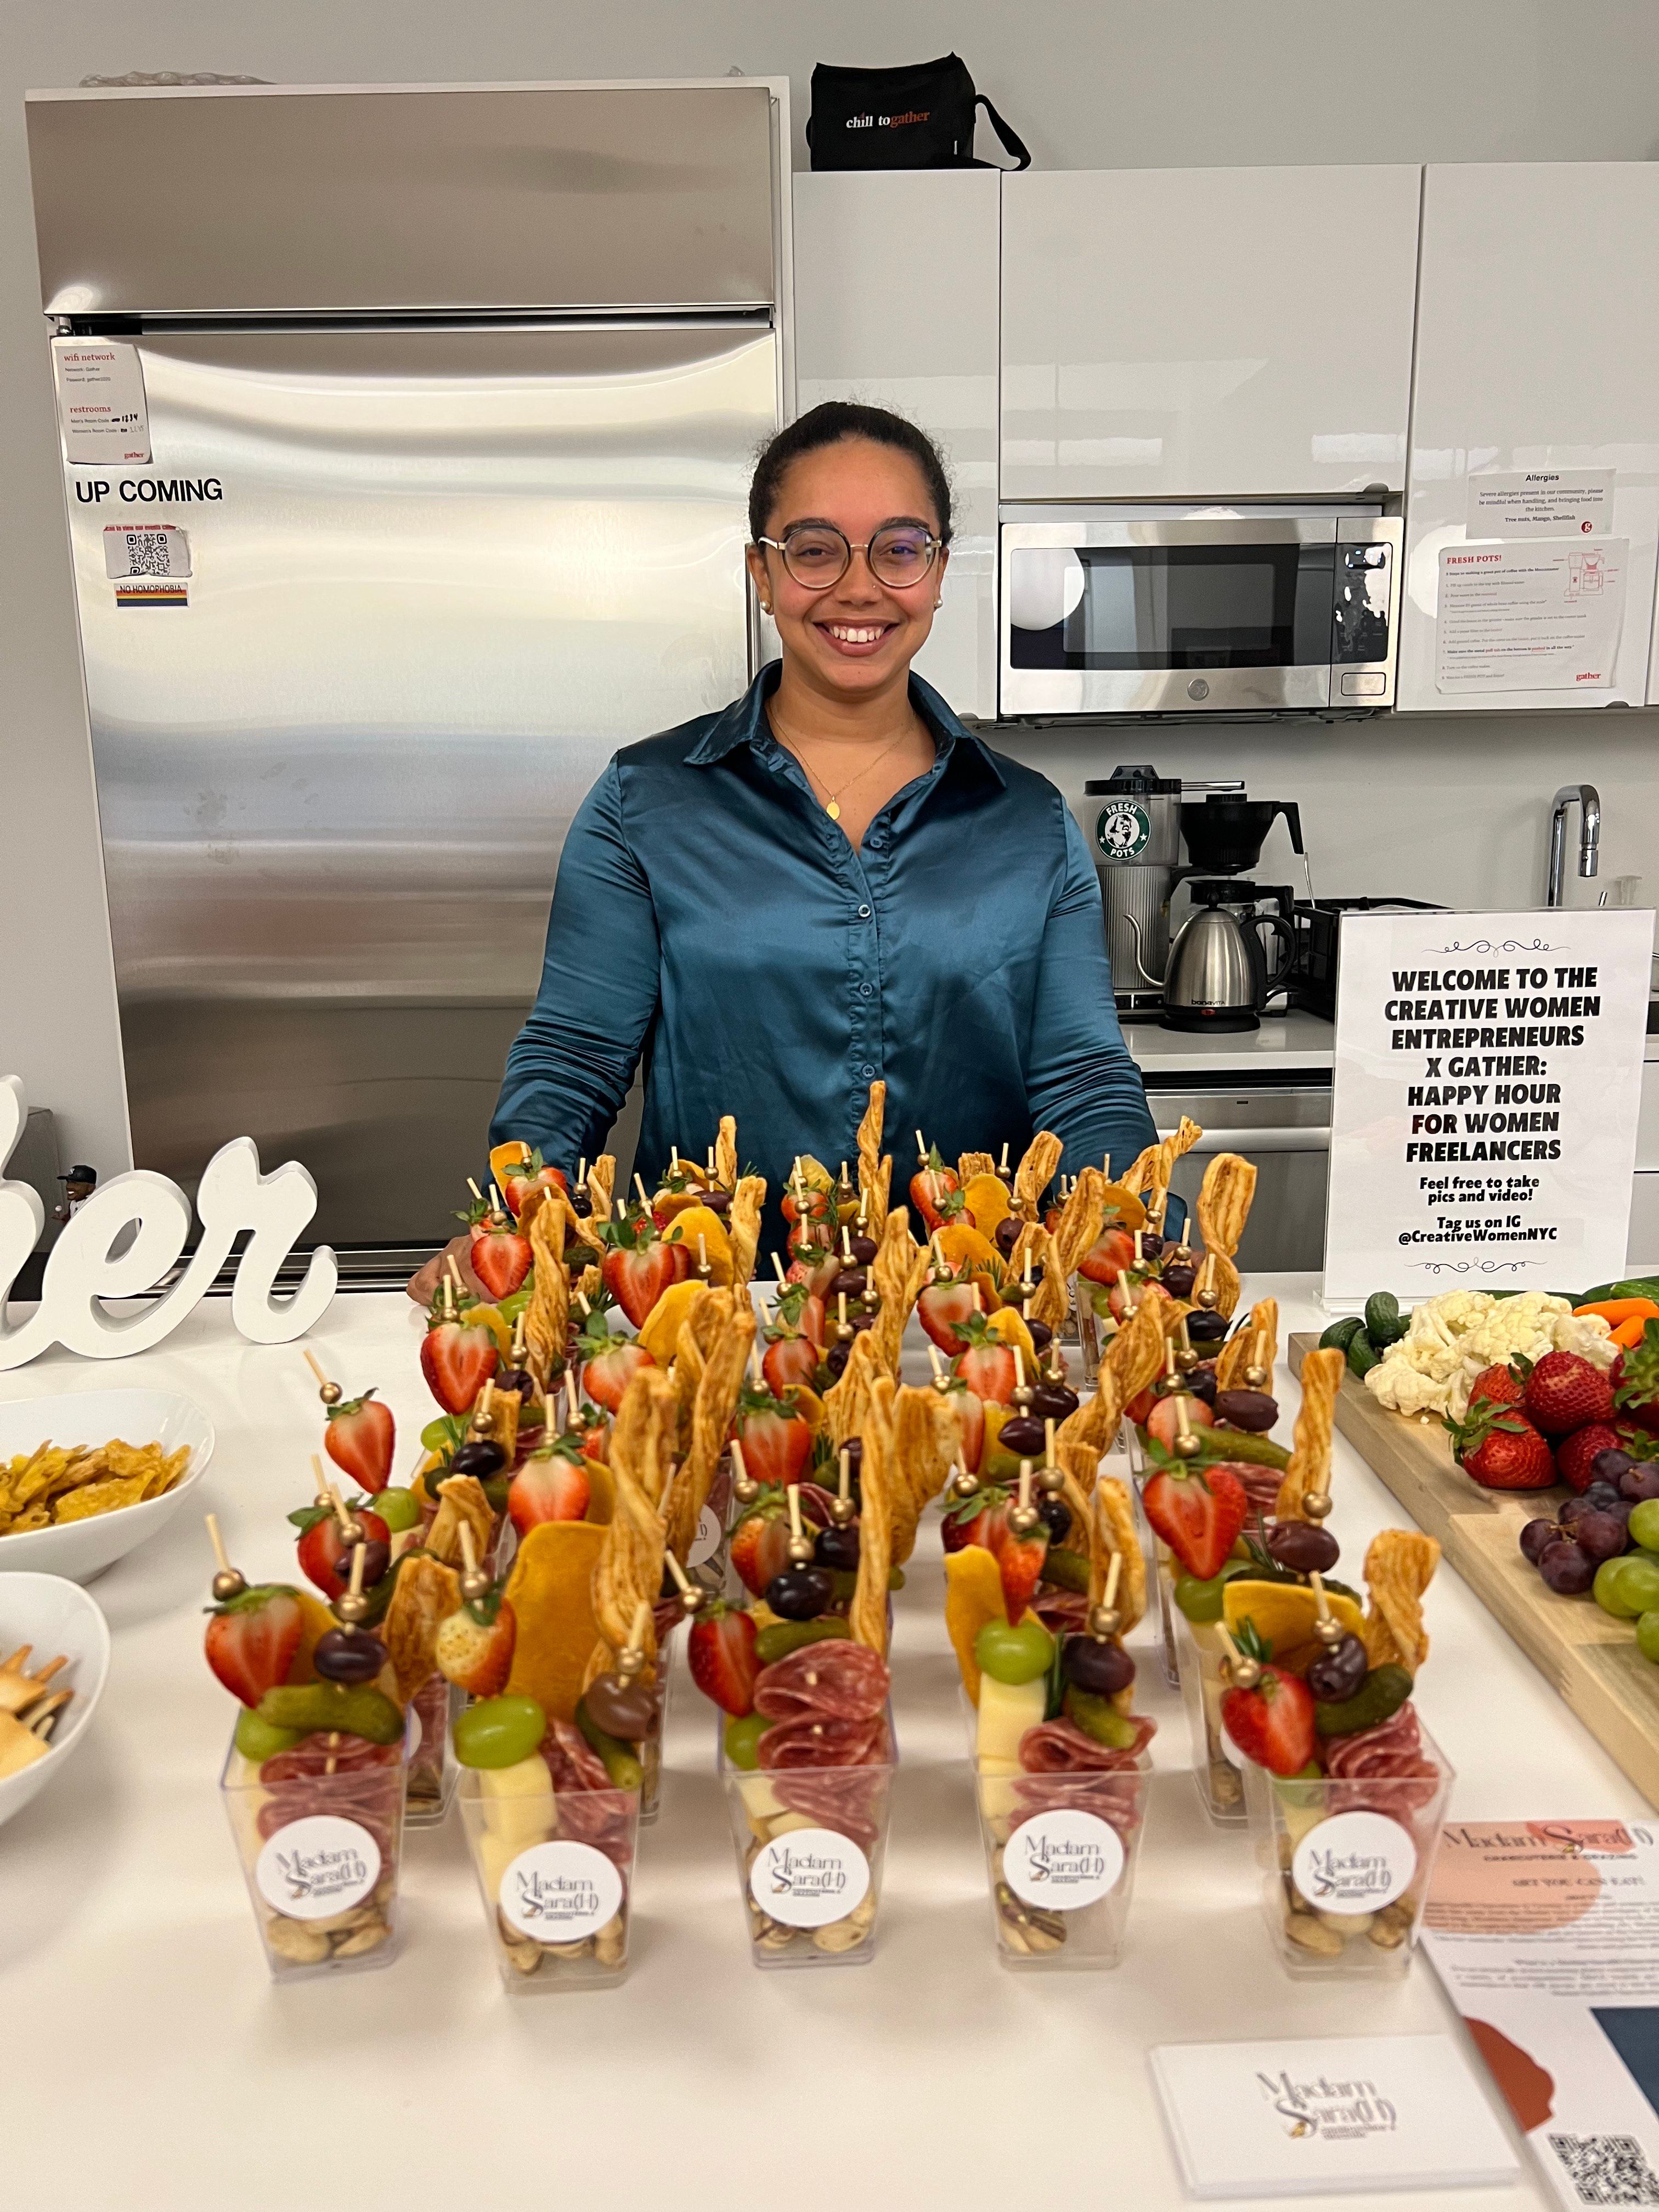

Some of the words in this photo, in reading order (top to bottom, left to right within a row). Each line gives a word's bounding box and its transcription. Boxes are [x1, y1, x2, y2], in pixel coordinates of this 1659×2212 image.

[846, 112, 873, 128] chill
[878, 111, 930, 128] togather
[64, 353, 80, 362] wifi
[81, 352, 116, 361] network
[122, 413, 138, 423] 1234
[124, 452, 144, 460] gather
[1525, 473, 1559, 483] Allergies
[76, 481, 110, 503] UP
[119, 478, 223, 503] COMING
[1447, 556, 1474, 565] FRESH
[1476, 555, 1502, 563] POTS!
[120, 585, 131, 594] NO
[132, 584, 183, 594] HOMOPHOBIA
[1576, 672, 1601, 681] gather
[1105, 803, 1138, 816] FRESH
[1110, 847, 1135, 857] POTS
[1392, 969, 1510, 992] WELCOME
[1516, 968, 1548, 989] TO
[1554, 967, 1598, 989] THE
[1384, 998, 1498, 1021] CREATIVE
[1504, 996, 1601, 1019] WOMEN
[1391, 1025, 1584, 1050] ENTREPRENEURS
[1425, 1057, 1442, 1078] X
[1448, 1055, 1547, 1078] GATHER:
[1408, 1085, 1489, 1107] HAPPY
[1494, 1084, 1561, 1105] HOUR
[1412, 1114, 1458, 1135] FOR
[1464, 1111, 1560, 1133] WOMEN
[1406, 1139, 1561, 1163] FREELANCERS
[1419, 1176, 1449, 1190] Feel
[1452, 1176, 1482, 1189] free
[1486, 1177, 1503, 1189] to
[1505, 1175, 1540, 1188] take
[1427, 1190, 1455, 1206] pics
[1458, 1189, 1485, 1203] and
[1488, 1188, 1533, 1201] video!
[1436, 1216, 1462, 1232] Tag
[1465, 1218, 1481, 1229] us
[1484, 1218, 1503, 1228] on
[1506, 1215, 1521, 1228] IG
[1398, 1227, 1558, 1245] @CreativeWomenNYC
[1025, 1834, 1100, 1860] Madam
[275, 1848, 358, 1877] Madam
[768, 1847, 842, 1874] Madam
[517, 1870, 594, 1898] Madam
[1256, 2070, 1378, 2110] Madam
